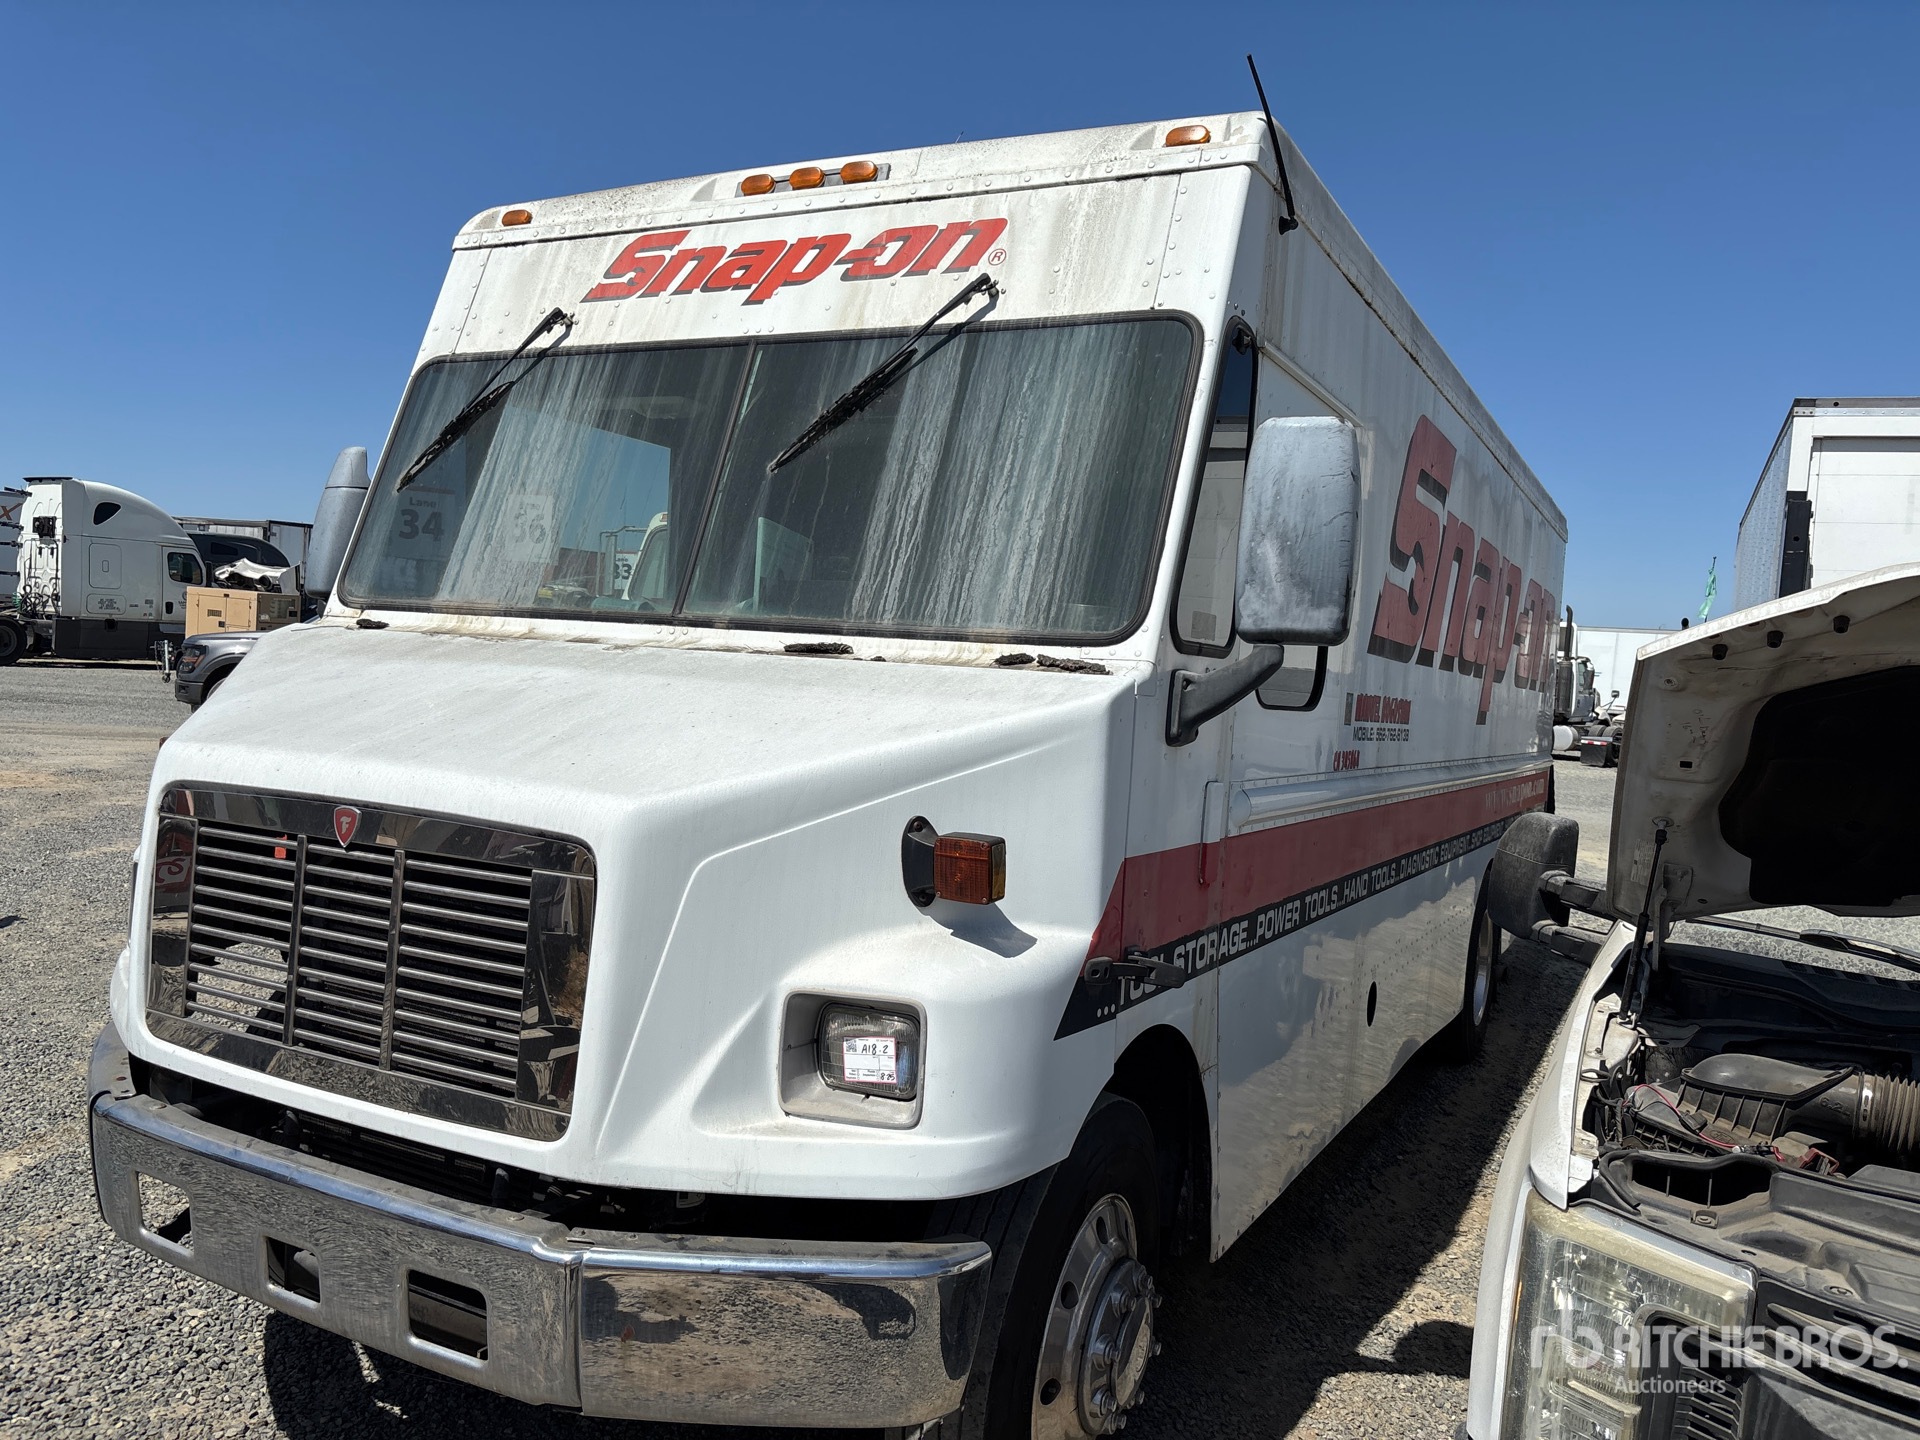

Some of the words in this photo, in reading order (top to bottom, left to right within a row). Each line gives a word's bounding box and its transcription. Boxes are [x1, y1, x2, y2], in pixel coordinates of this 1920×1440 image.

[579, 217, 1008, 306] Snap-on
[398, 508, 444, 542] 34
[409, 496, 437, 509] Lane
[1367, 414, 1556, 725] Snap-on
